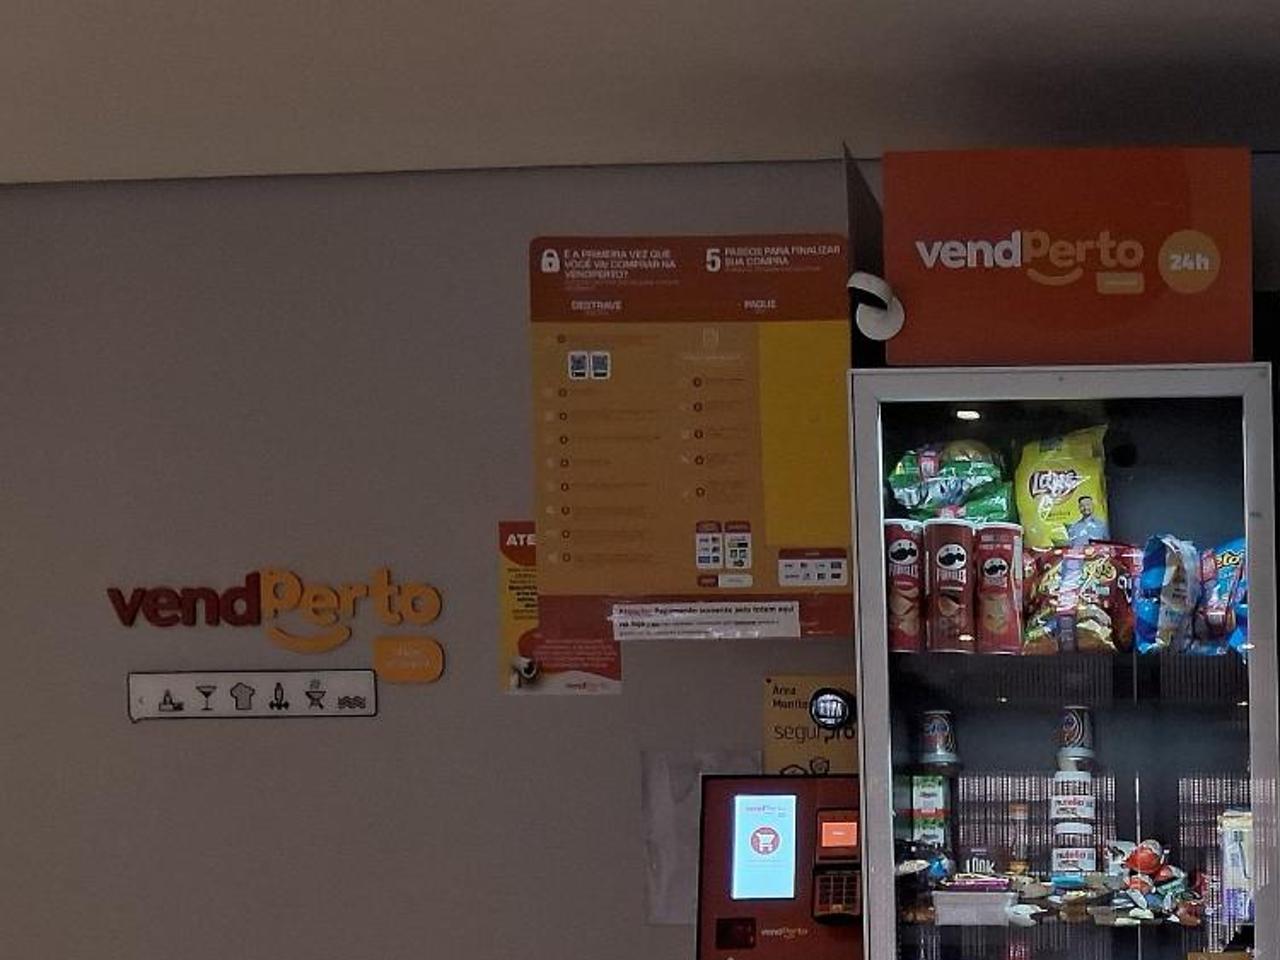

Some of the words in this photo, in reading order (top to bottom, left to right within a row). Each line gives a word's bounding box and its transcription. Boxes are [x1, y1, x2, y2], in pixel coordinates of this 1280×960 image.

[705, 248, 722, 273] 5
[915, 230, 1145, 269] vendPerto
[1170, 254, 1210, 270] 24h
[106, 562, 443, 628] vendPerto
